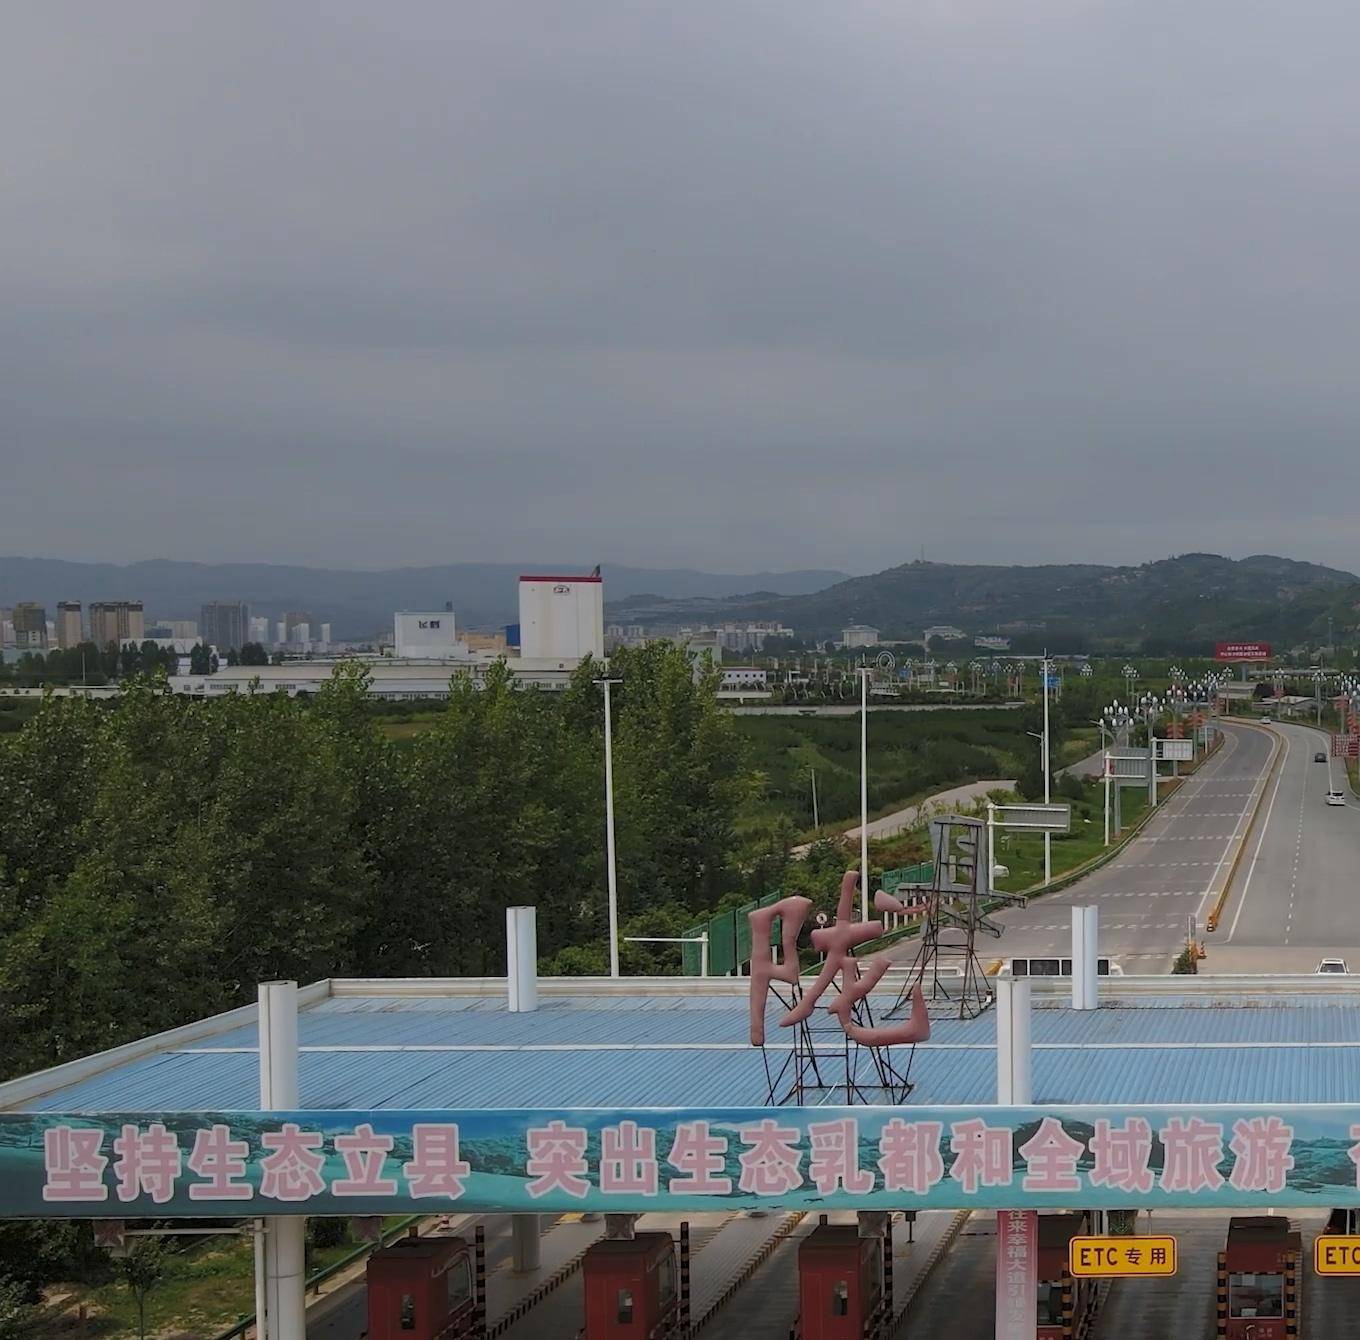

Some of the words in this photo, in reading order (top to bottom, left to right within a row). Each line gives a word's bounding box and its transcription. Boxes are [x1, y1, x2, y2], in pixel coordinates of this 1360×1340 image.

[42, 1123, 470, 1203] 坚持生态立县
[526, 1116, 1295, 1197] 突出生态乳都和全域旅游
[1080, 1247, 1118, 1266] ETC
[1124, 1247, 1167, 1265] 专用
